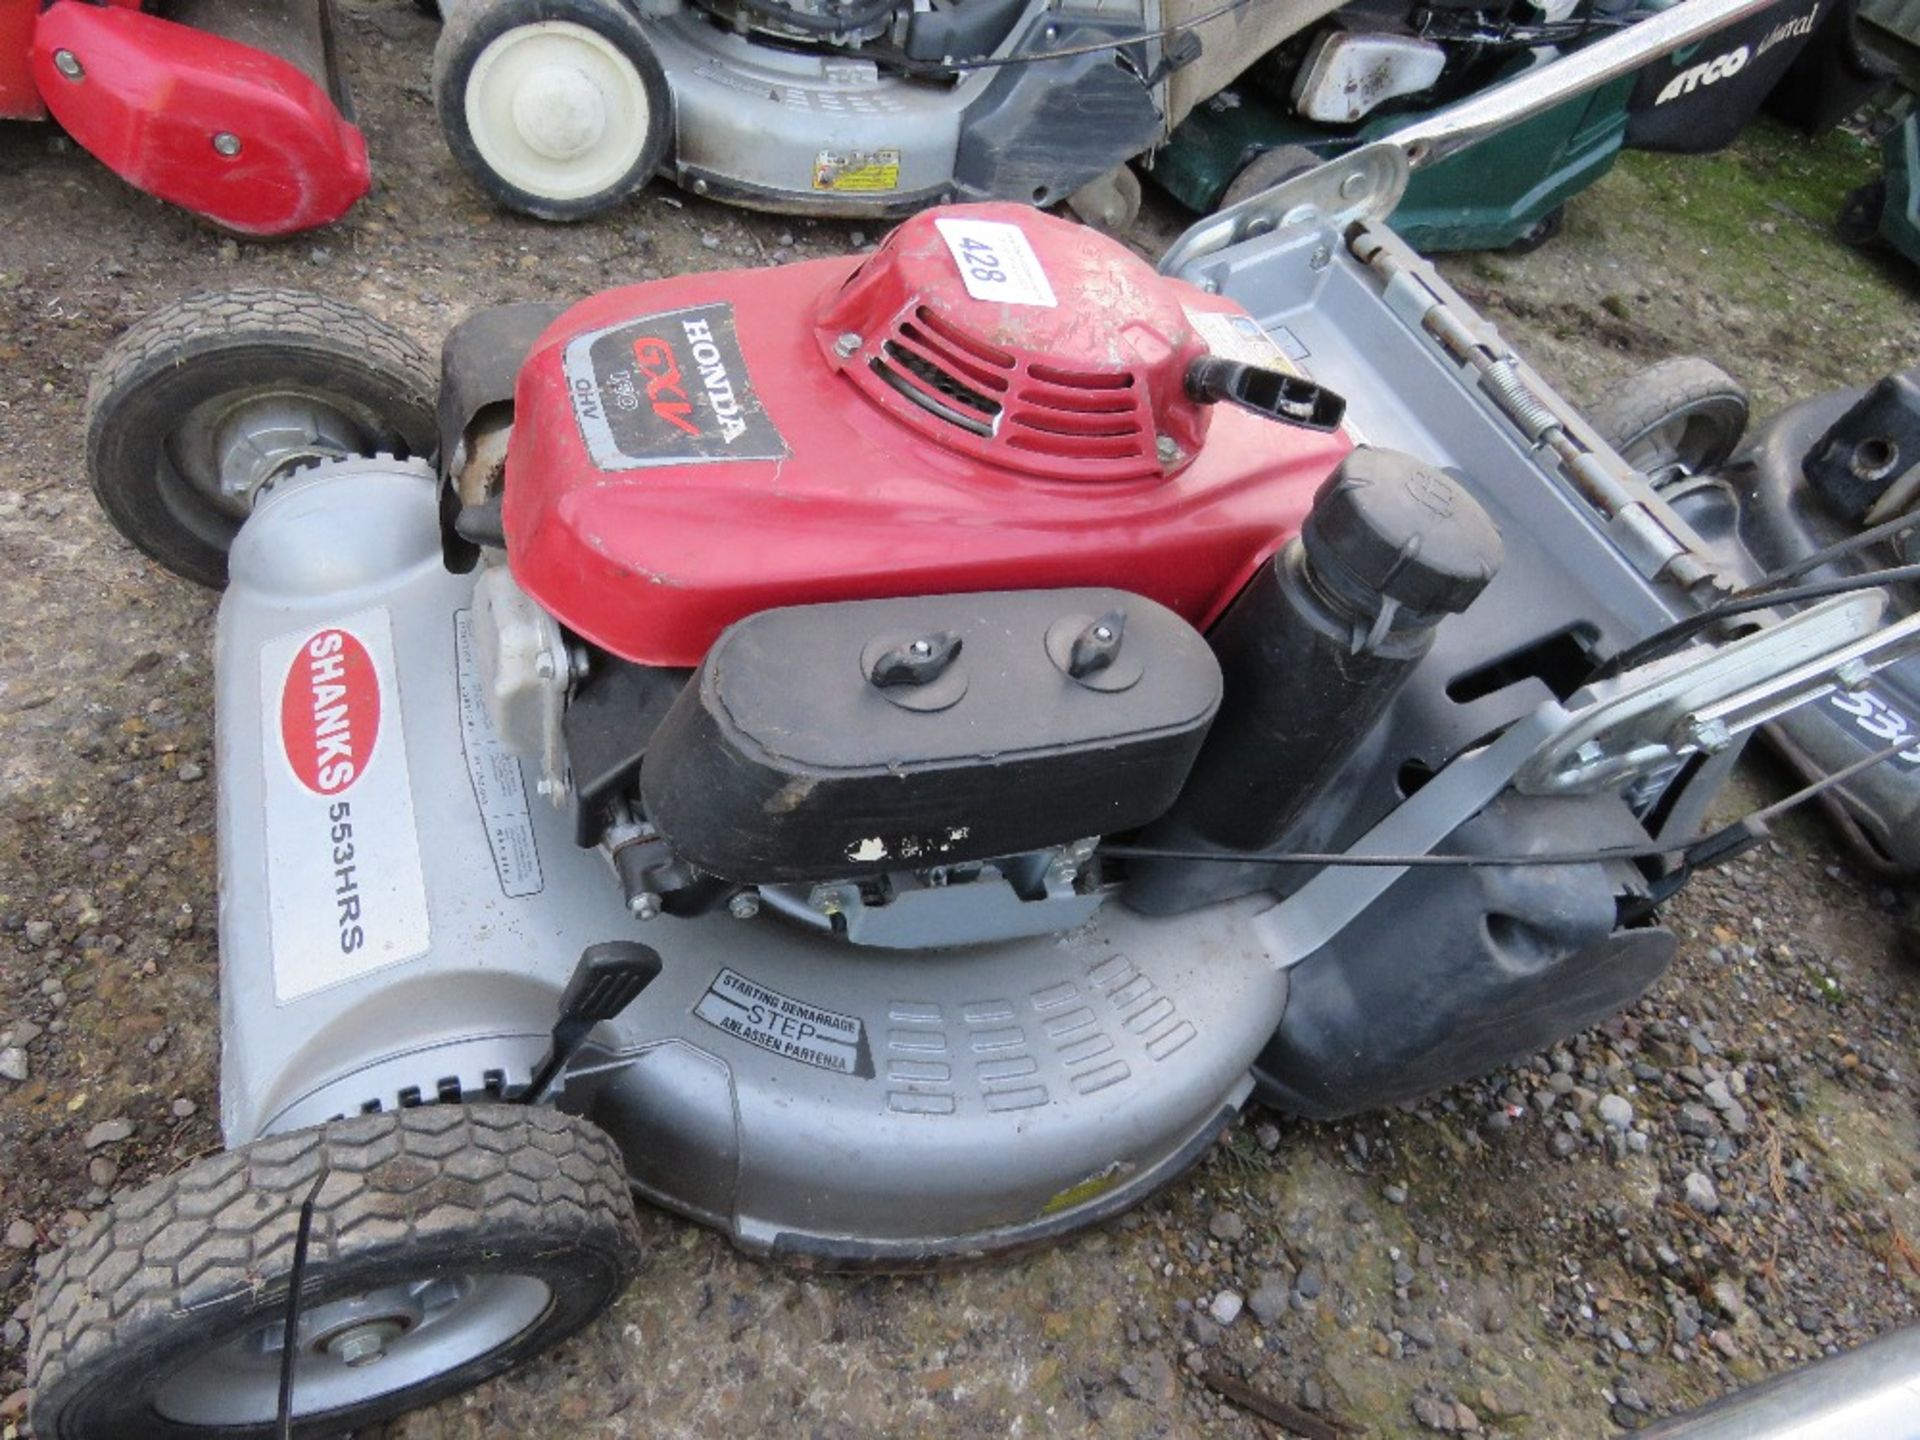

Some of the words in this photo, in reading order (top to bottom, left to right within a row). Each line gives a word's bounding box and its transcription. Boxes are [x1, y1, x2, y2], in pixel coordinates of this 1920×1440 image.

[1655, 45, 1750, 106] ATCO
[959, 237, 1007, 283] 428
[575, 378, 600, 421] OHV
[632, 337, 701, 437] GXV
[682, 318, 748, 444] HONDA
[310, 632, 355, 792] SHANKS
[329, 801, 365, 955] 553HRS
[723, 974, 780, 1008] STARTING
[780, 1000, 856, 1034] DEMARRAGE
[747, 1004, 817, 1041] STEP
[719, 1015, 783, 1051] ANLASSEN
[783, 1041, 847, 1070] PARTENZA
